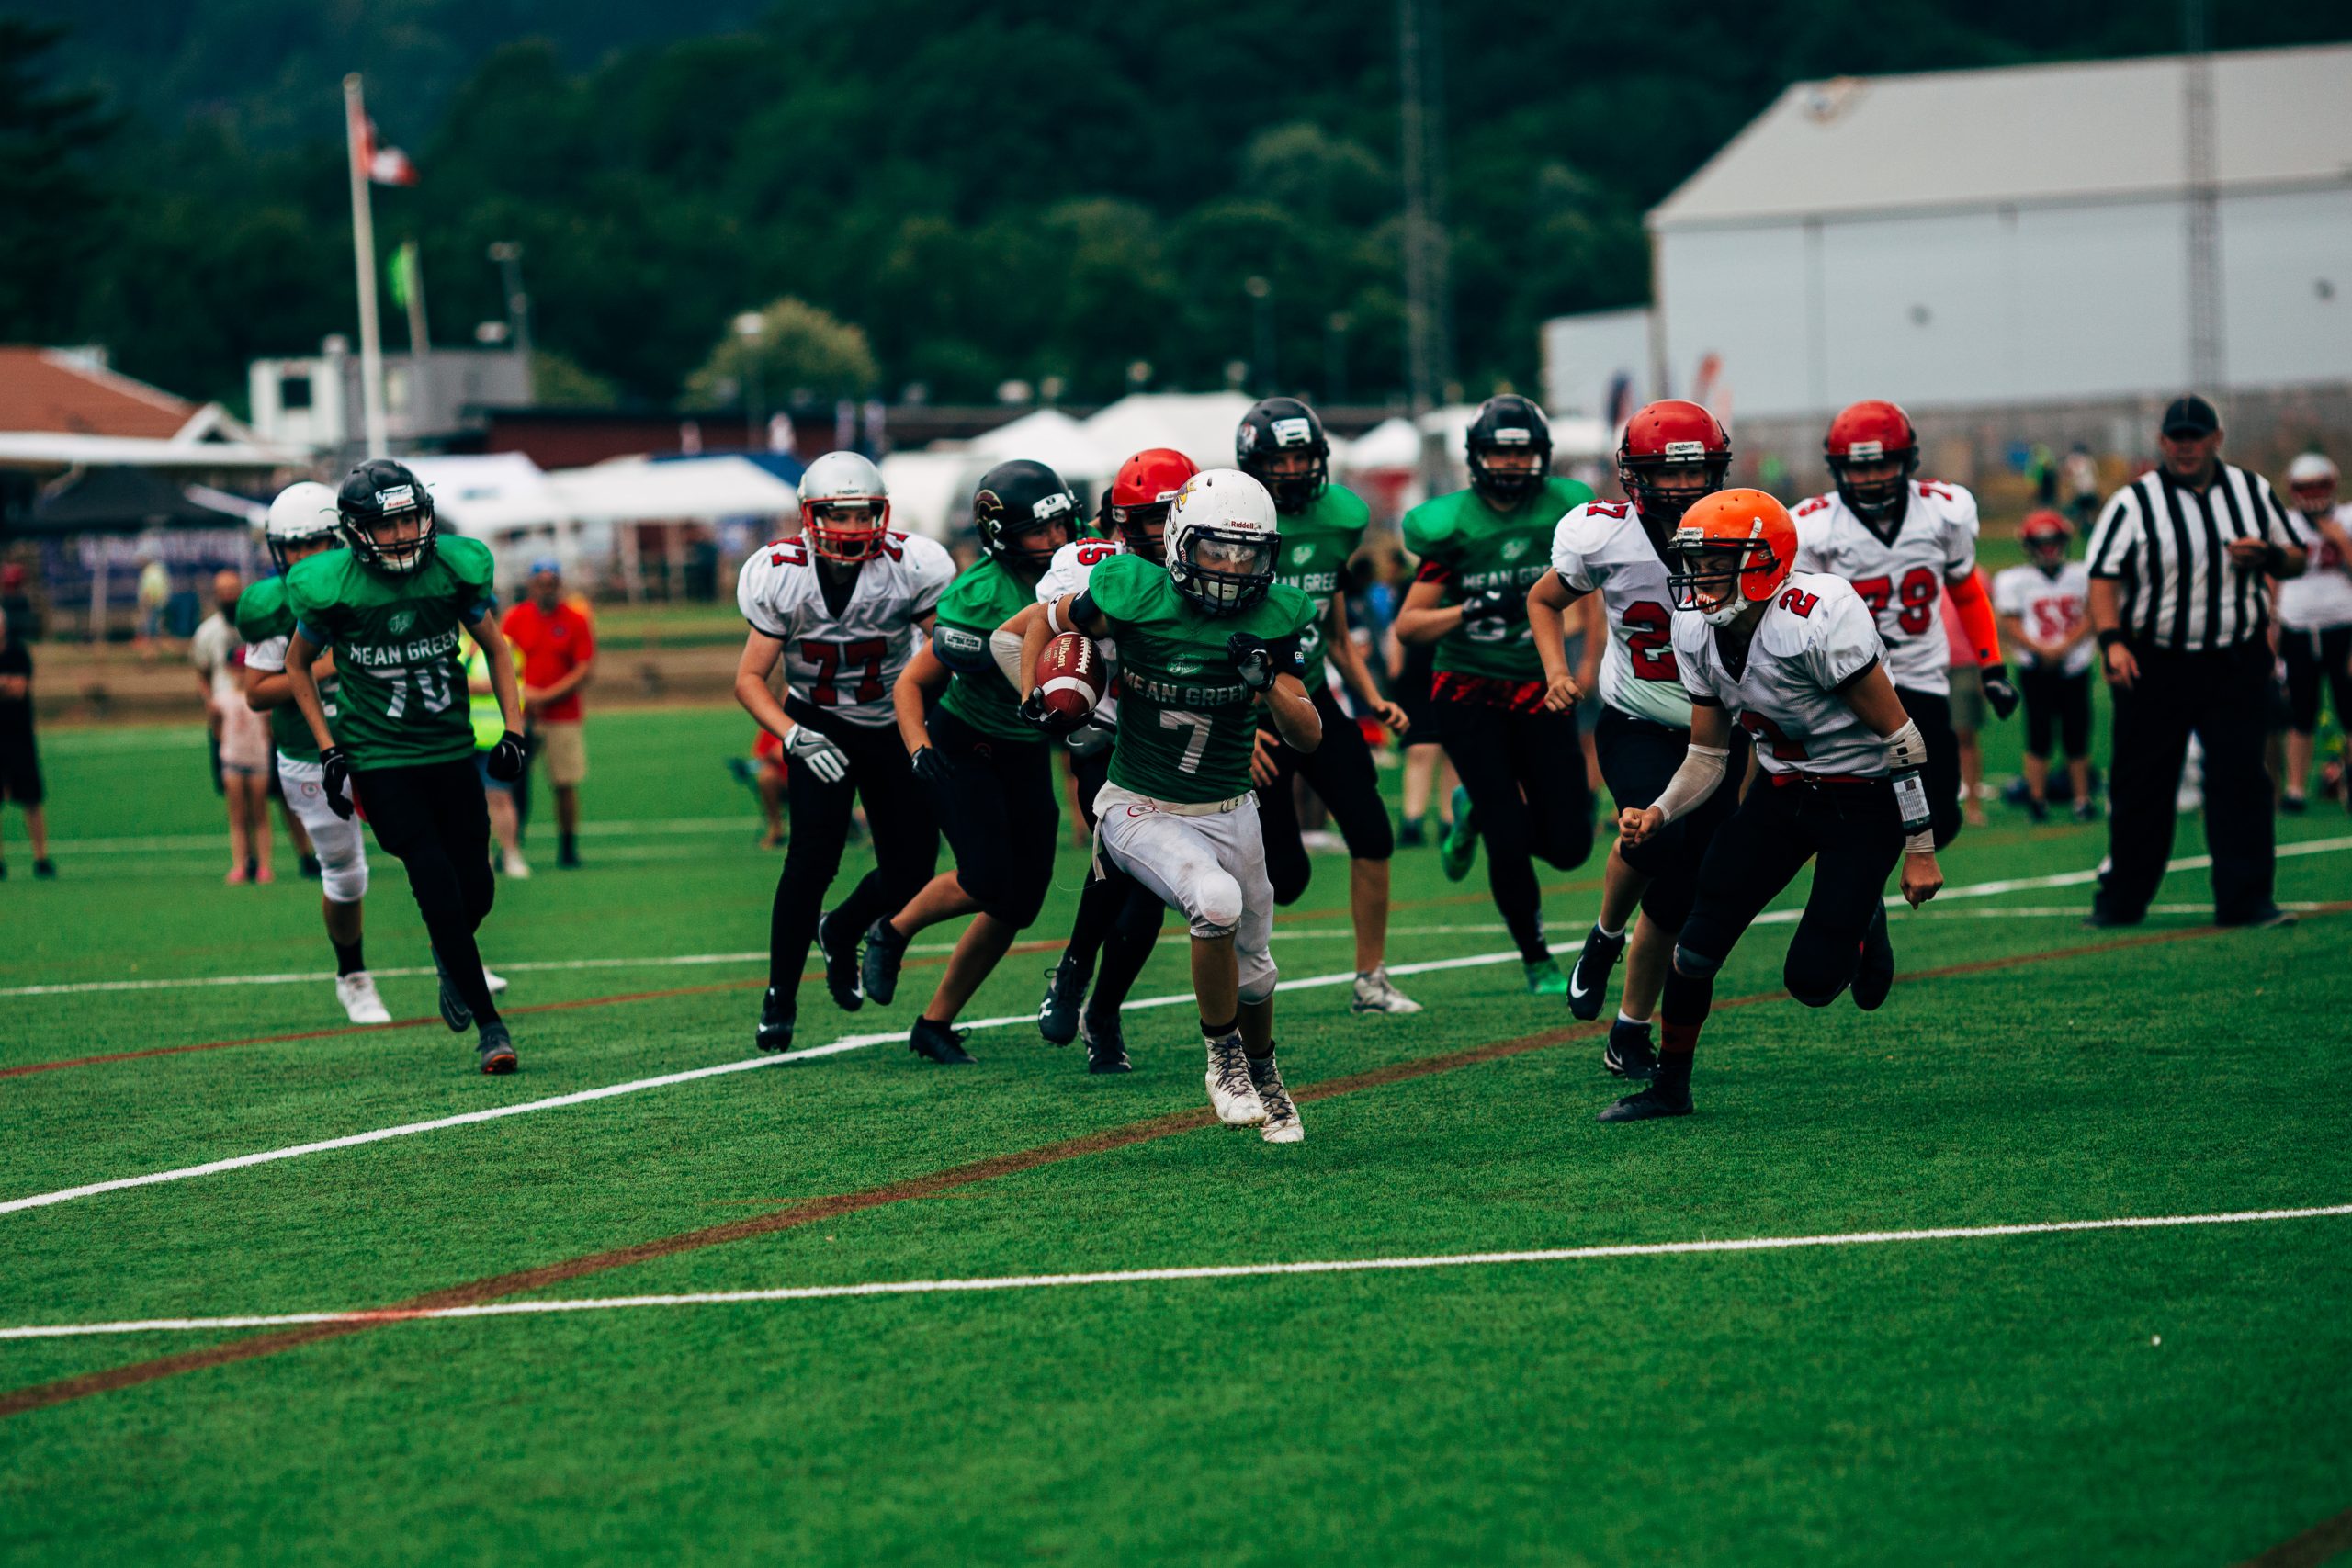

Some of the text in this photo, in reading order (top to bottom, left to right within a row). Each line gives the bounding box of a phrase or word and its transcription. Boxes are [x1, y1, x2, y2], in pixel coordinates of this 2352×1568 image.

[1231, 520, 1254, 530] Riddell
[1779, 587, 1820, 618] 2
[1849, 565, 1938, 636] 79
[350, 643, 401, 665] MEAN
[799, 636, 888, 706] 77
[1057, 637, 1073, 668] Wilson
[366, 657, 451, 718] 70
[1123, 666, 1177, 704] MEAN
[1159, 709, 1213, 774] 7
